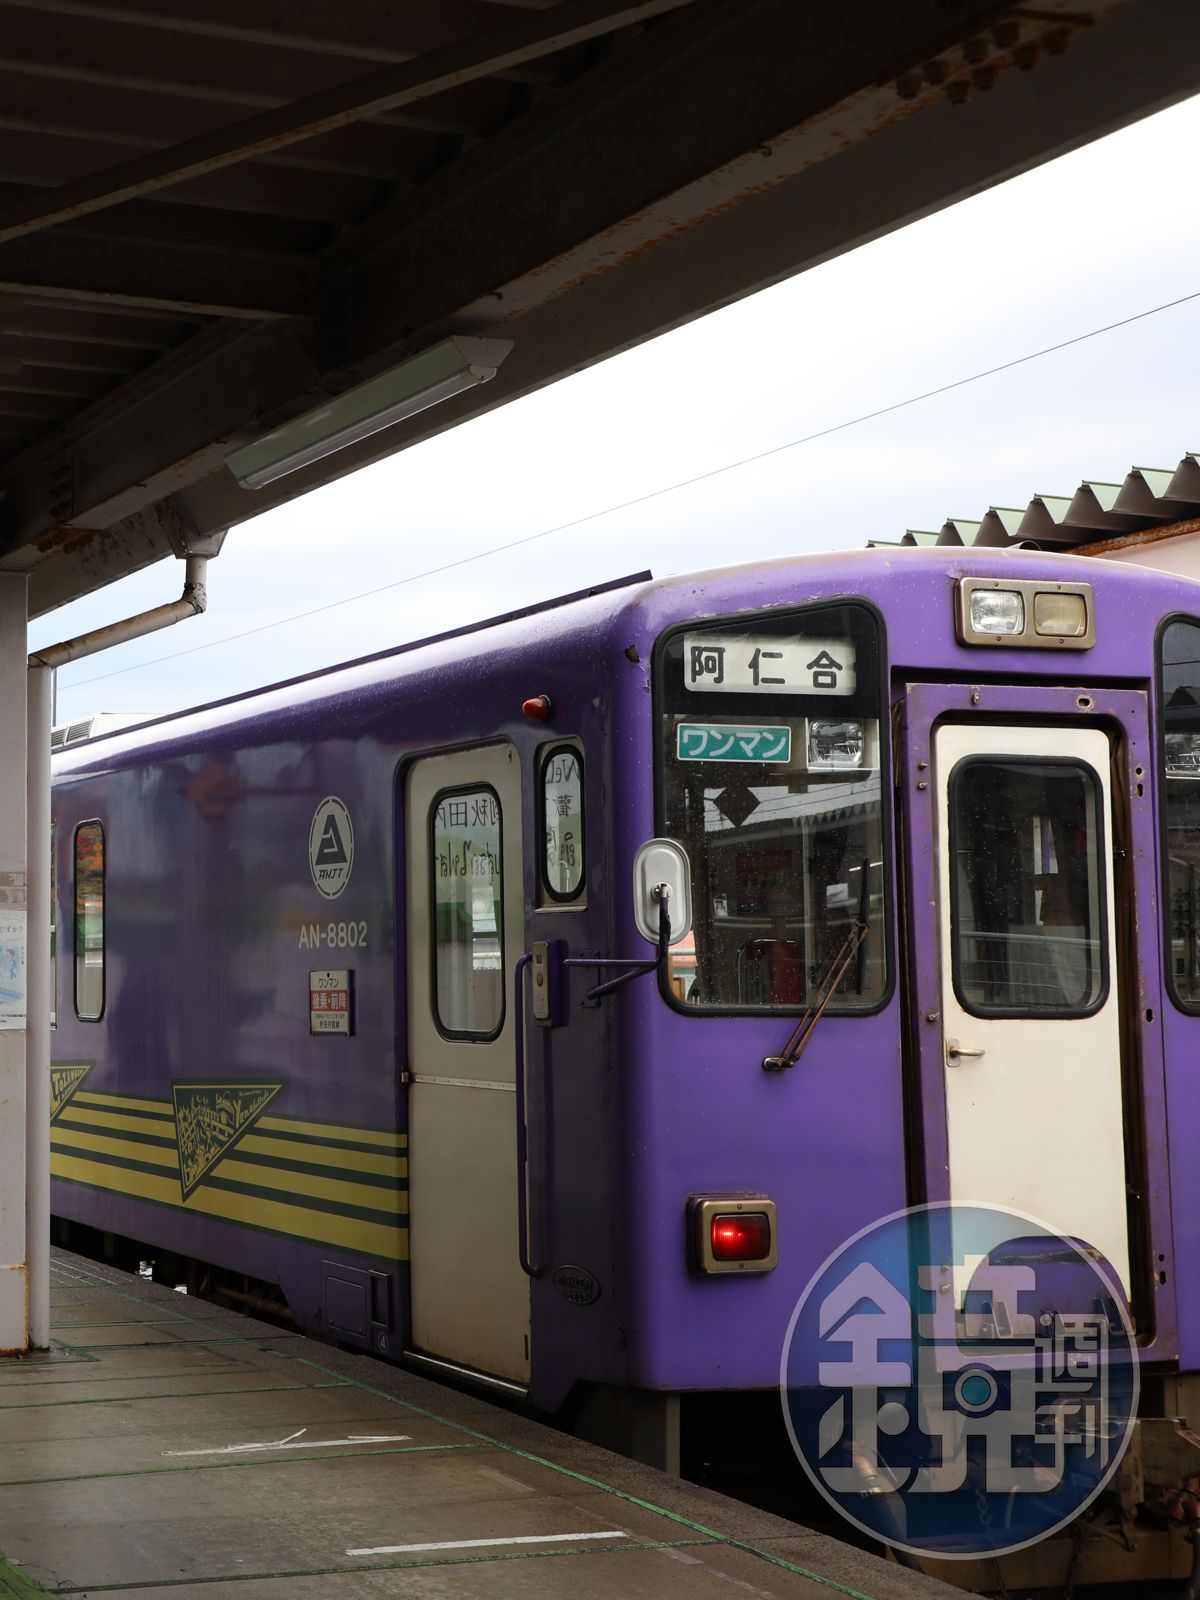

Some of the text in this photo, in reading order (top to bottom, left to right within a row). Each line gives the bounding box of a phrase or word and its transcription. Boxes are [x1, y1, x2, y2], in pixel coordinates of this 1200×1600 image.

[690, 646, 843, 689] 阿仁合
[683, 729, 787, 758] ワンマン
[299, 921, 368, 949] AN-8802
[319, 978, 339, 988] ワンマン
